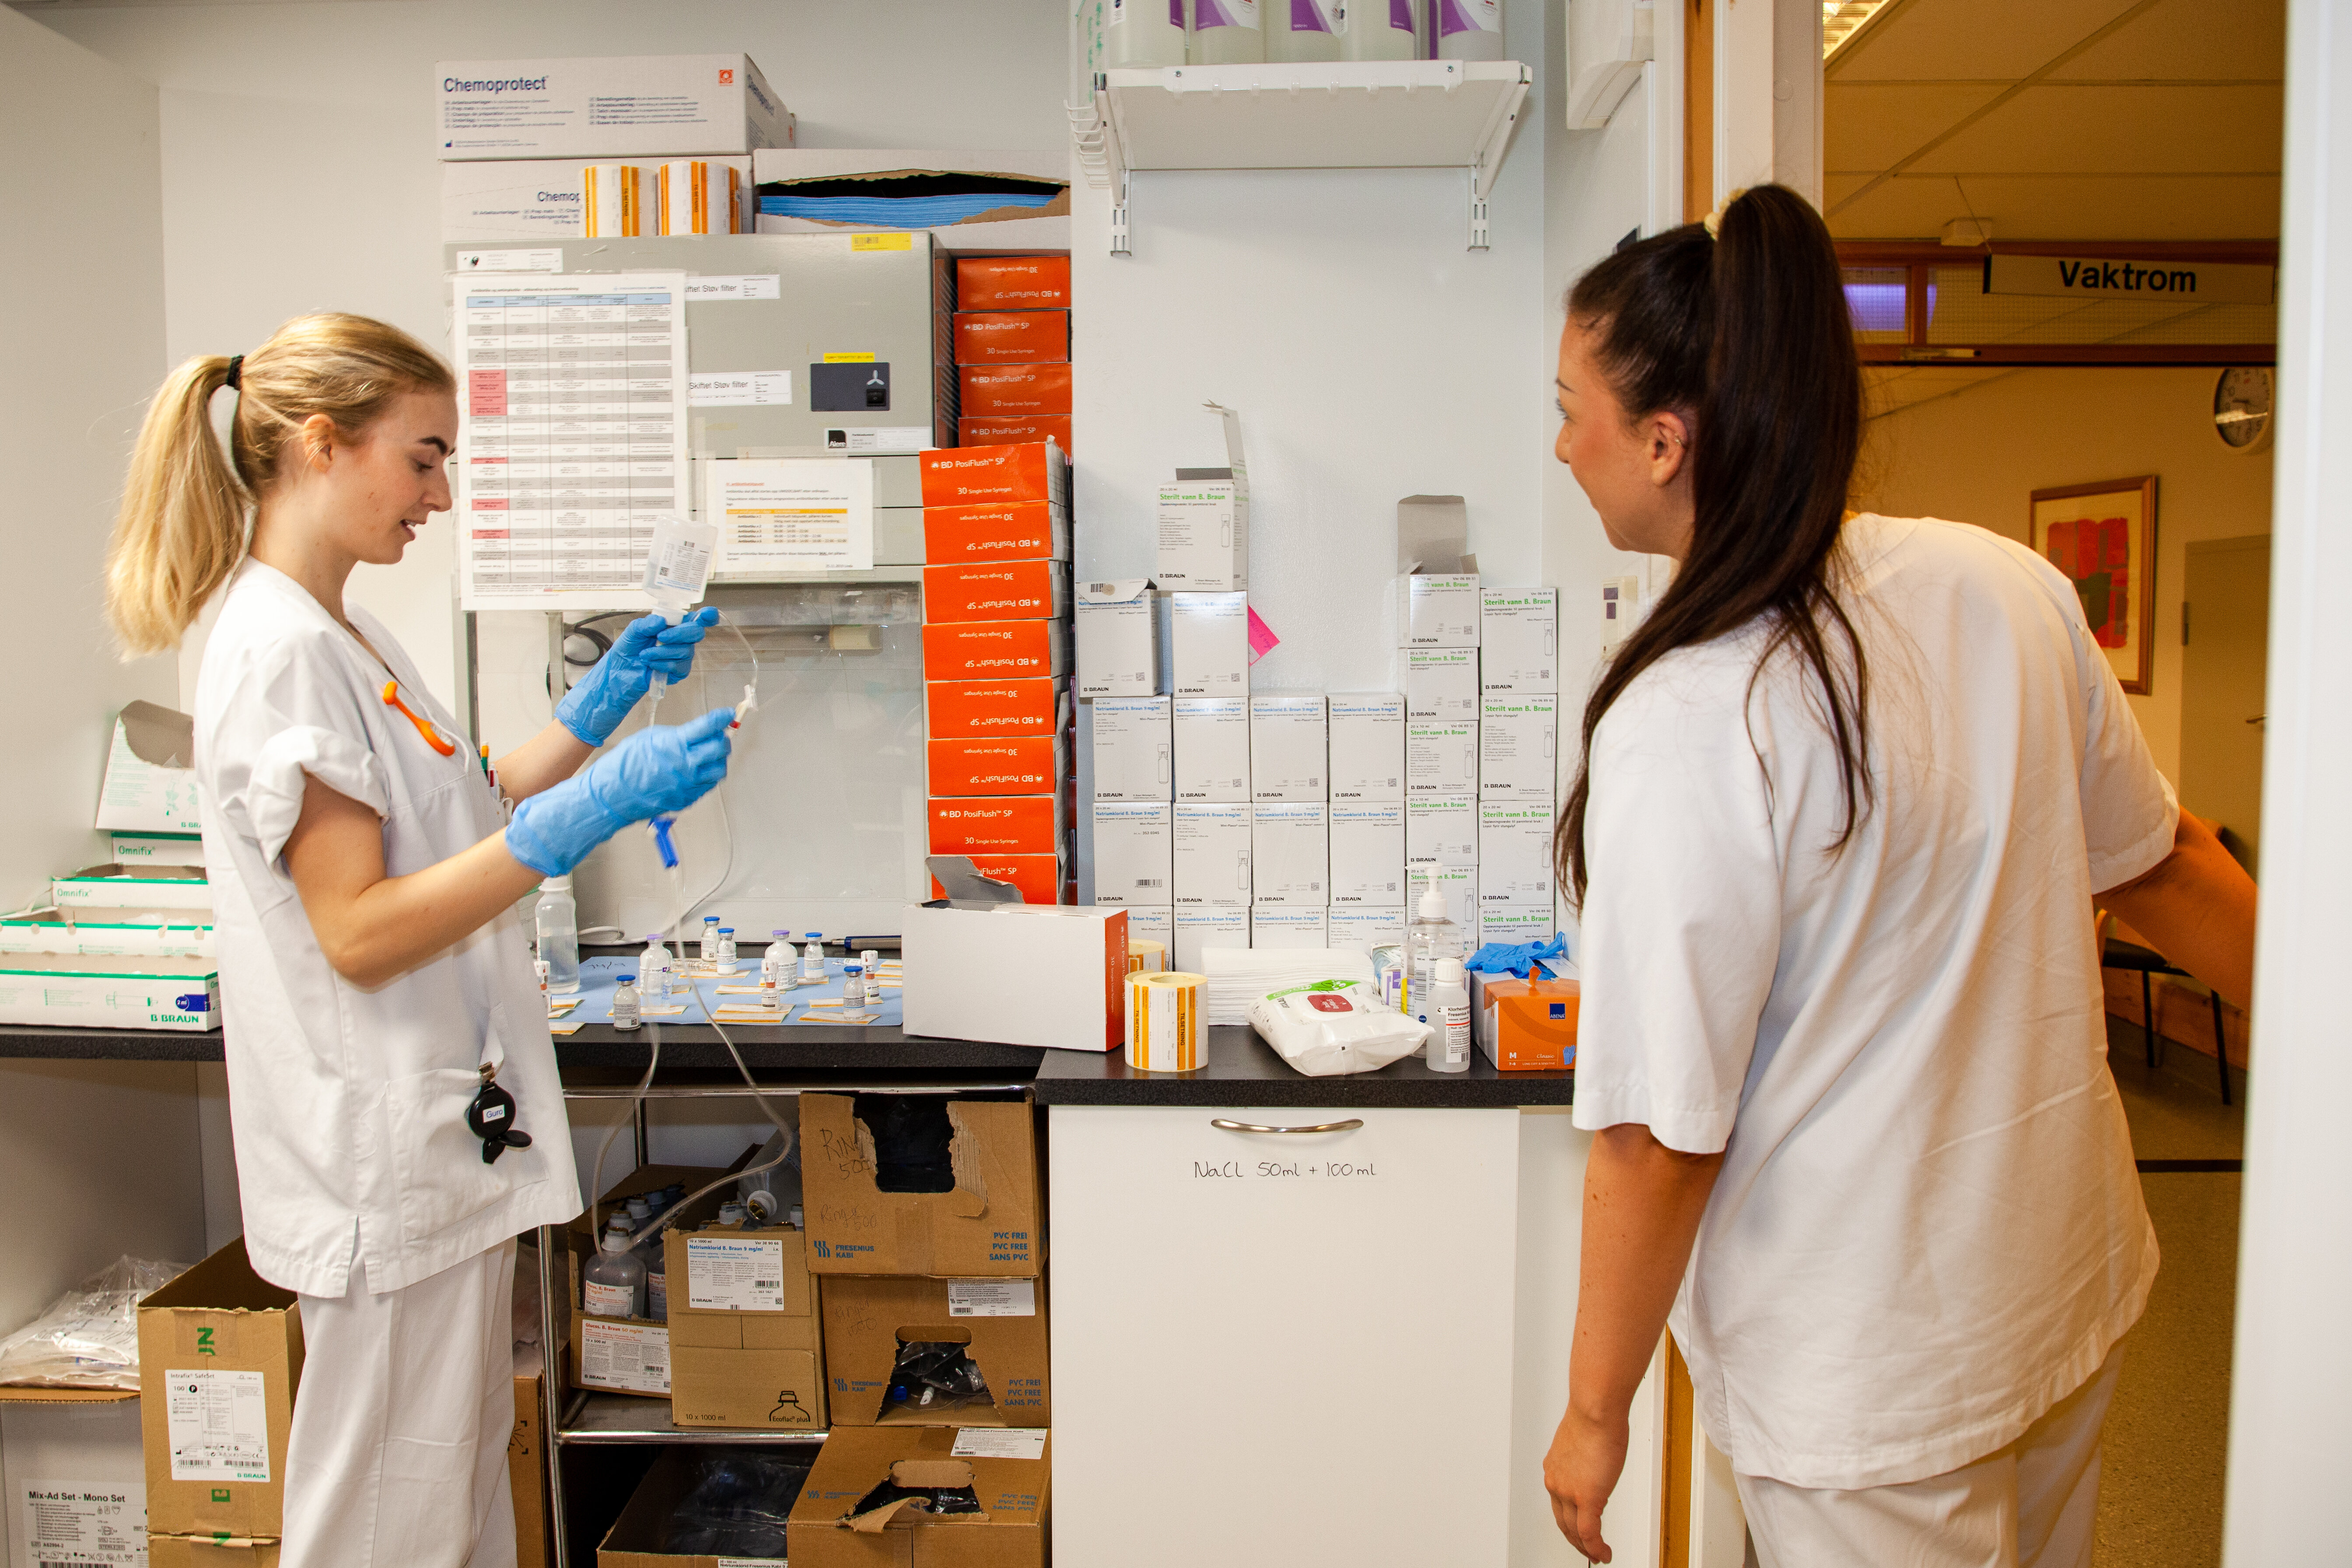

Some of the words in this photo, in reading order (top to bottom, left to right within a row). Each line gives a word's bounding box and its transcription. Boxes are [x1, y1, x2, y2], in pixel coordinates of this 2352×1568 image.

[444, 77, 547, 94] Chemoprotect
[2059, 261, 2196, 292] Vaktrom
[486, 1109, 503, 1118] Guro
[1194, 1162, 1244, 1177] NaCl
[1256, 1162, 1301, 1176] 50ml
[29, 1491, 58, 1500] Mix-Ad
[84, 1493, 108, 1502] Mono
[111, 1494, 125, 1502] Set
